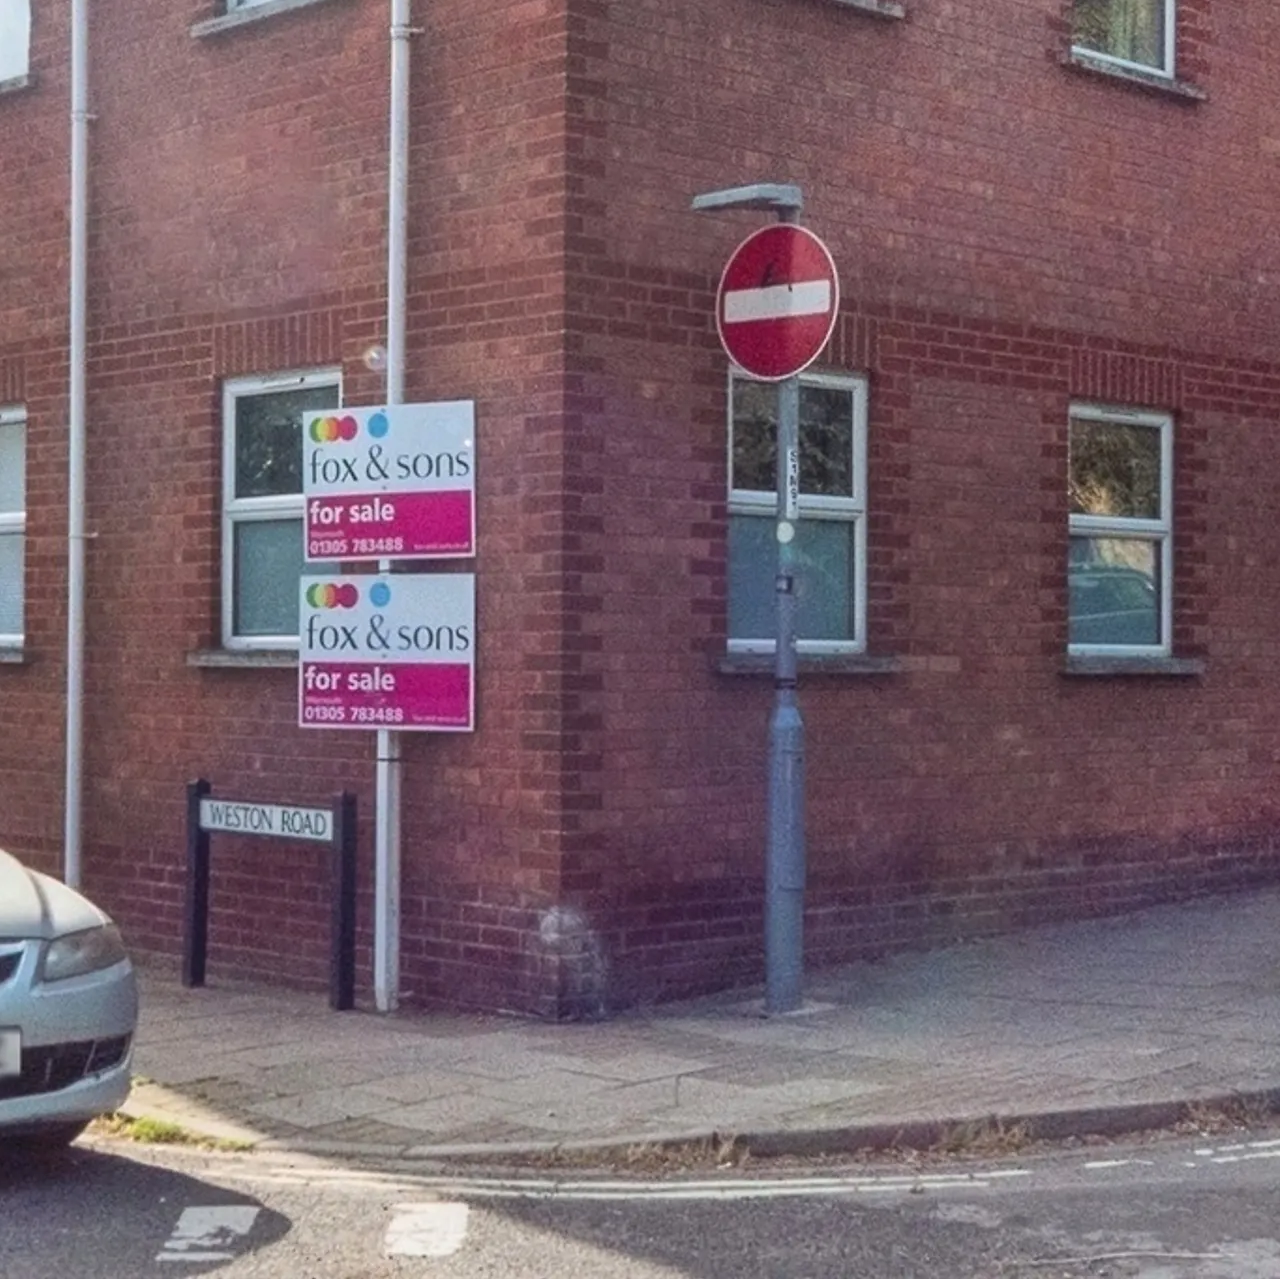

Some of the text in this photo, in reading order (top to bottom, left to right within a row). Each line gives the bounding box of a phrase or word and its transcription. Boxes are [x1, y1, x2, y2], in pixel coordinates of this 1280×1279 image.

[308, 444, 470, 484] fox & sons
[310, 497, 395, 524] for sale
[309, 539, 348, 554] 01305
[351, 537, 404, 553] 783488
[306, 614, 470, 651] fox & sons
[305, 666, 396, 691] for sale
[304, 706, 345, 720] 01305
[350, 707, 404, 722] 783488
[209, 803, 327, 836] WESTON ROAD
